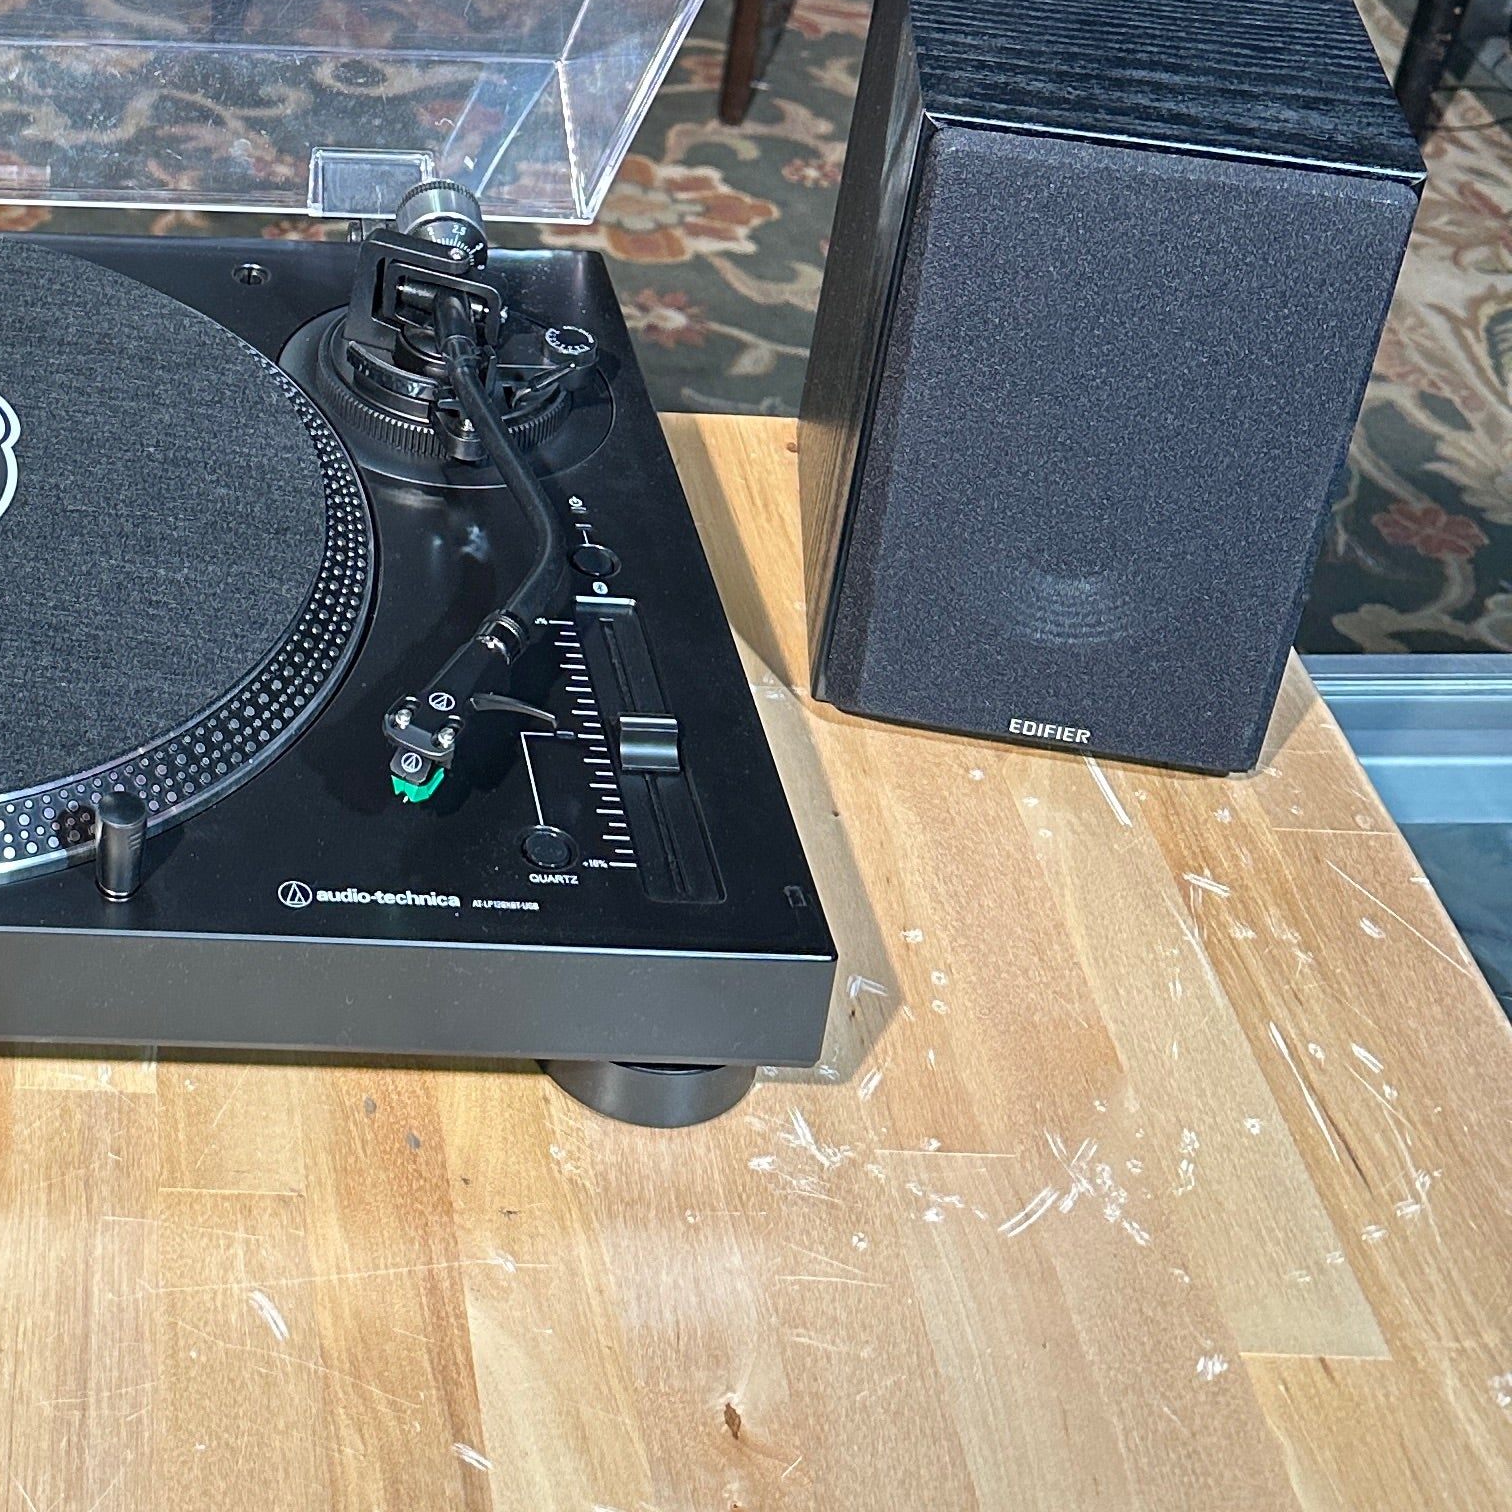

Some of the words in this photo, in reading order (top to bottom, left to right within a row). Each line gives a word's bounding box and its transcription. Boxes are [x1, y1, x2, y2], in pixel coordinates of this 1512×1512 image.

[1008, 718, 1092, 745] EDIFIER
[528, 873, 579, 885] QUARTZ
[316, 888, 461, 908] audio-technica
